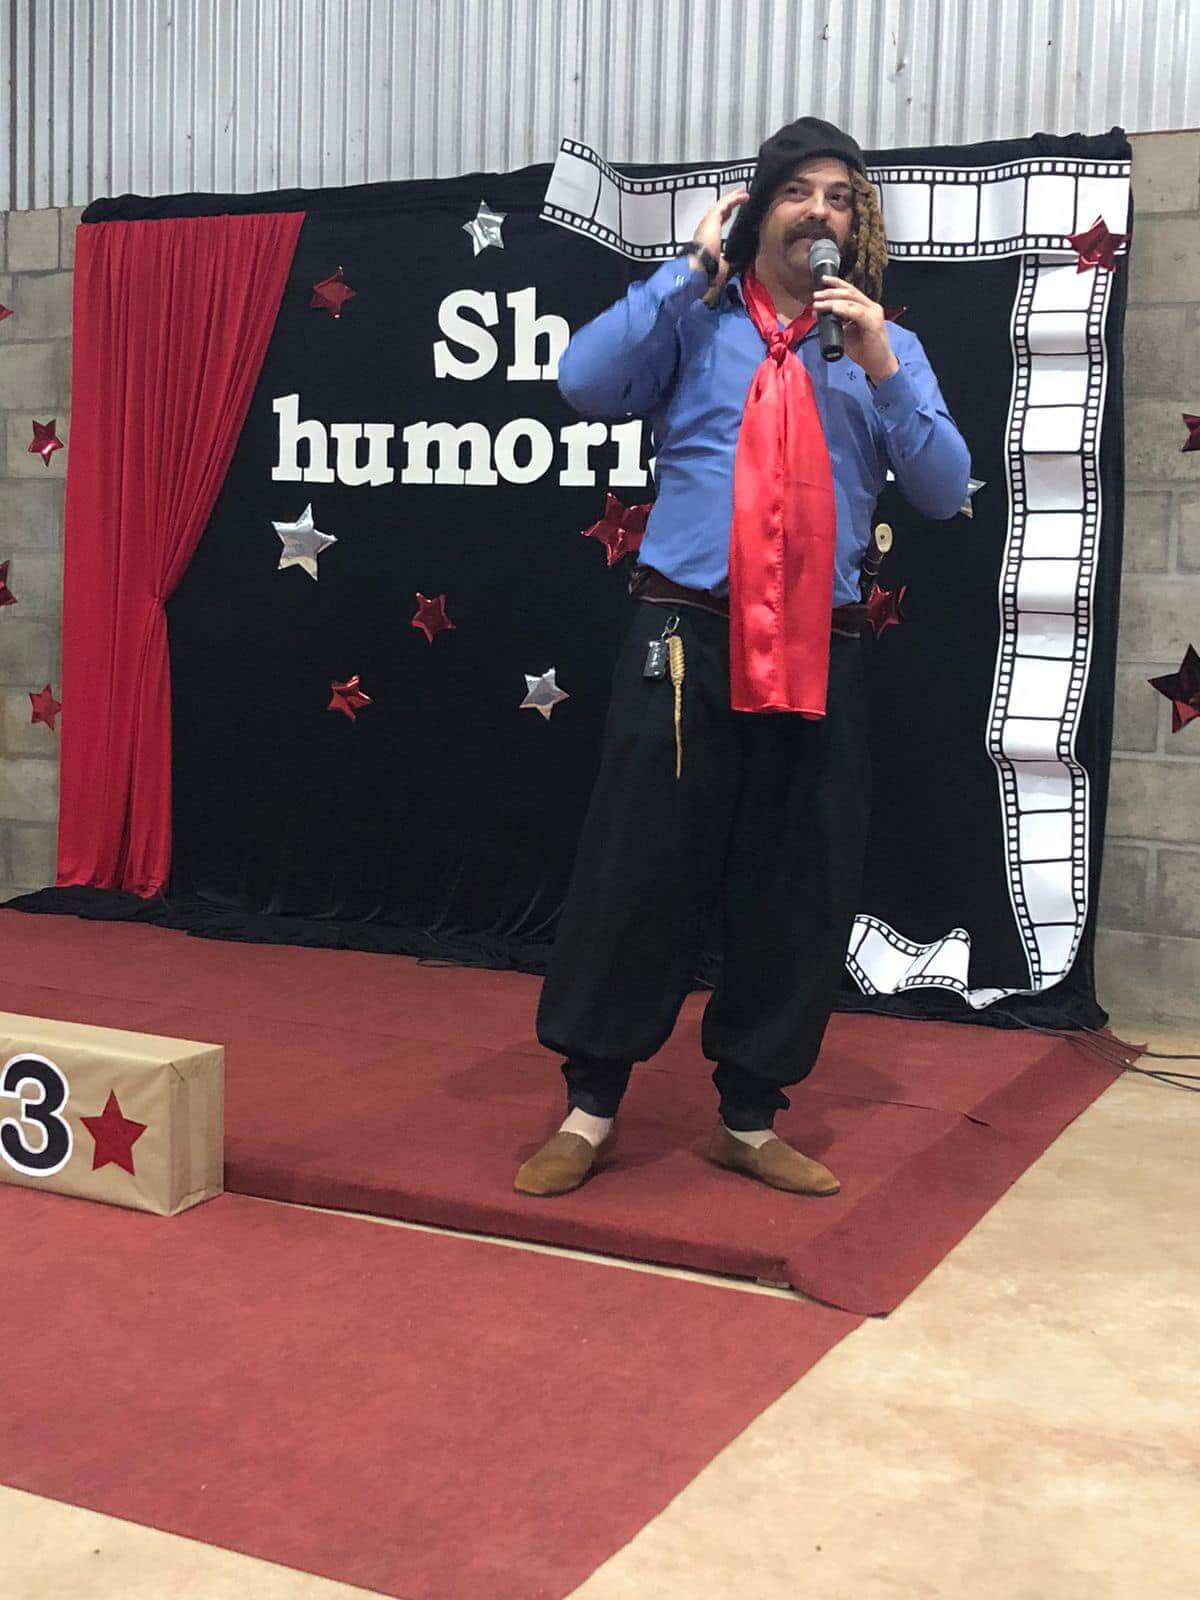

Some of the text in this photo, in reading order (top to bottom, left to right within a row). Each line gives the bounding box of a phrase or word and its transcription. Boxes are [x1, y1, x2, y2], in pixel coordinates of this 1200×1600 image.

[433, 287, 570, 381] Sh
[271, 393, 657, 487] humori
[0, 1053, 73, 1177] 3
